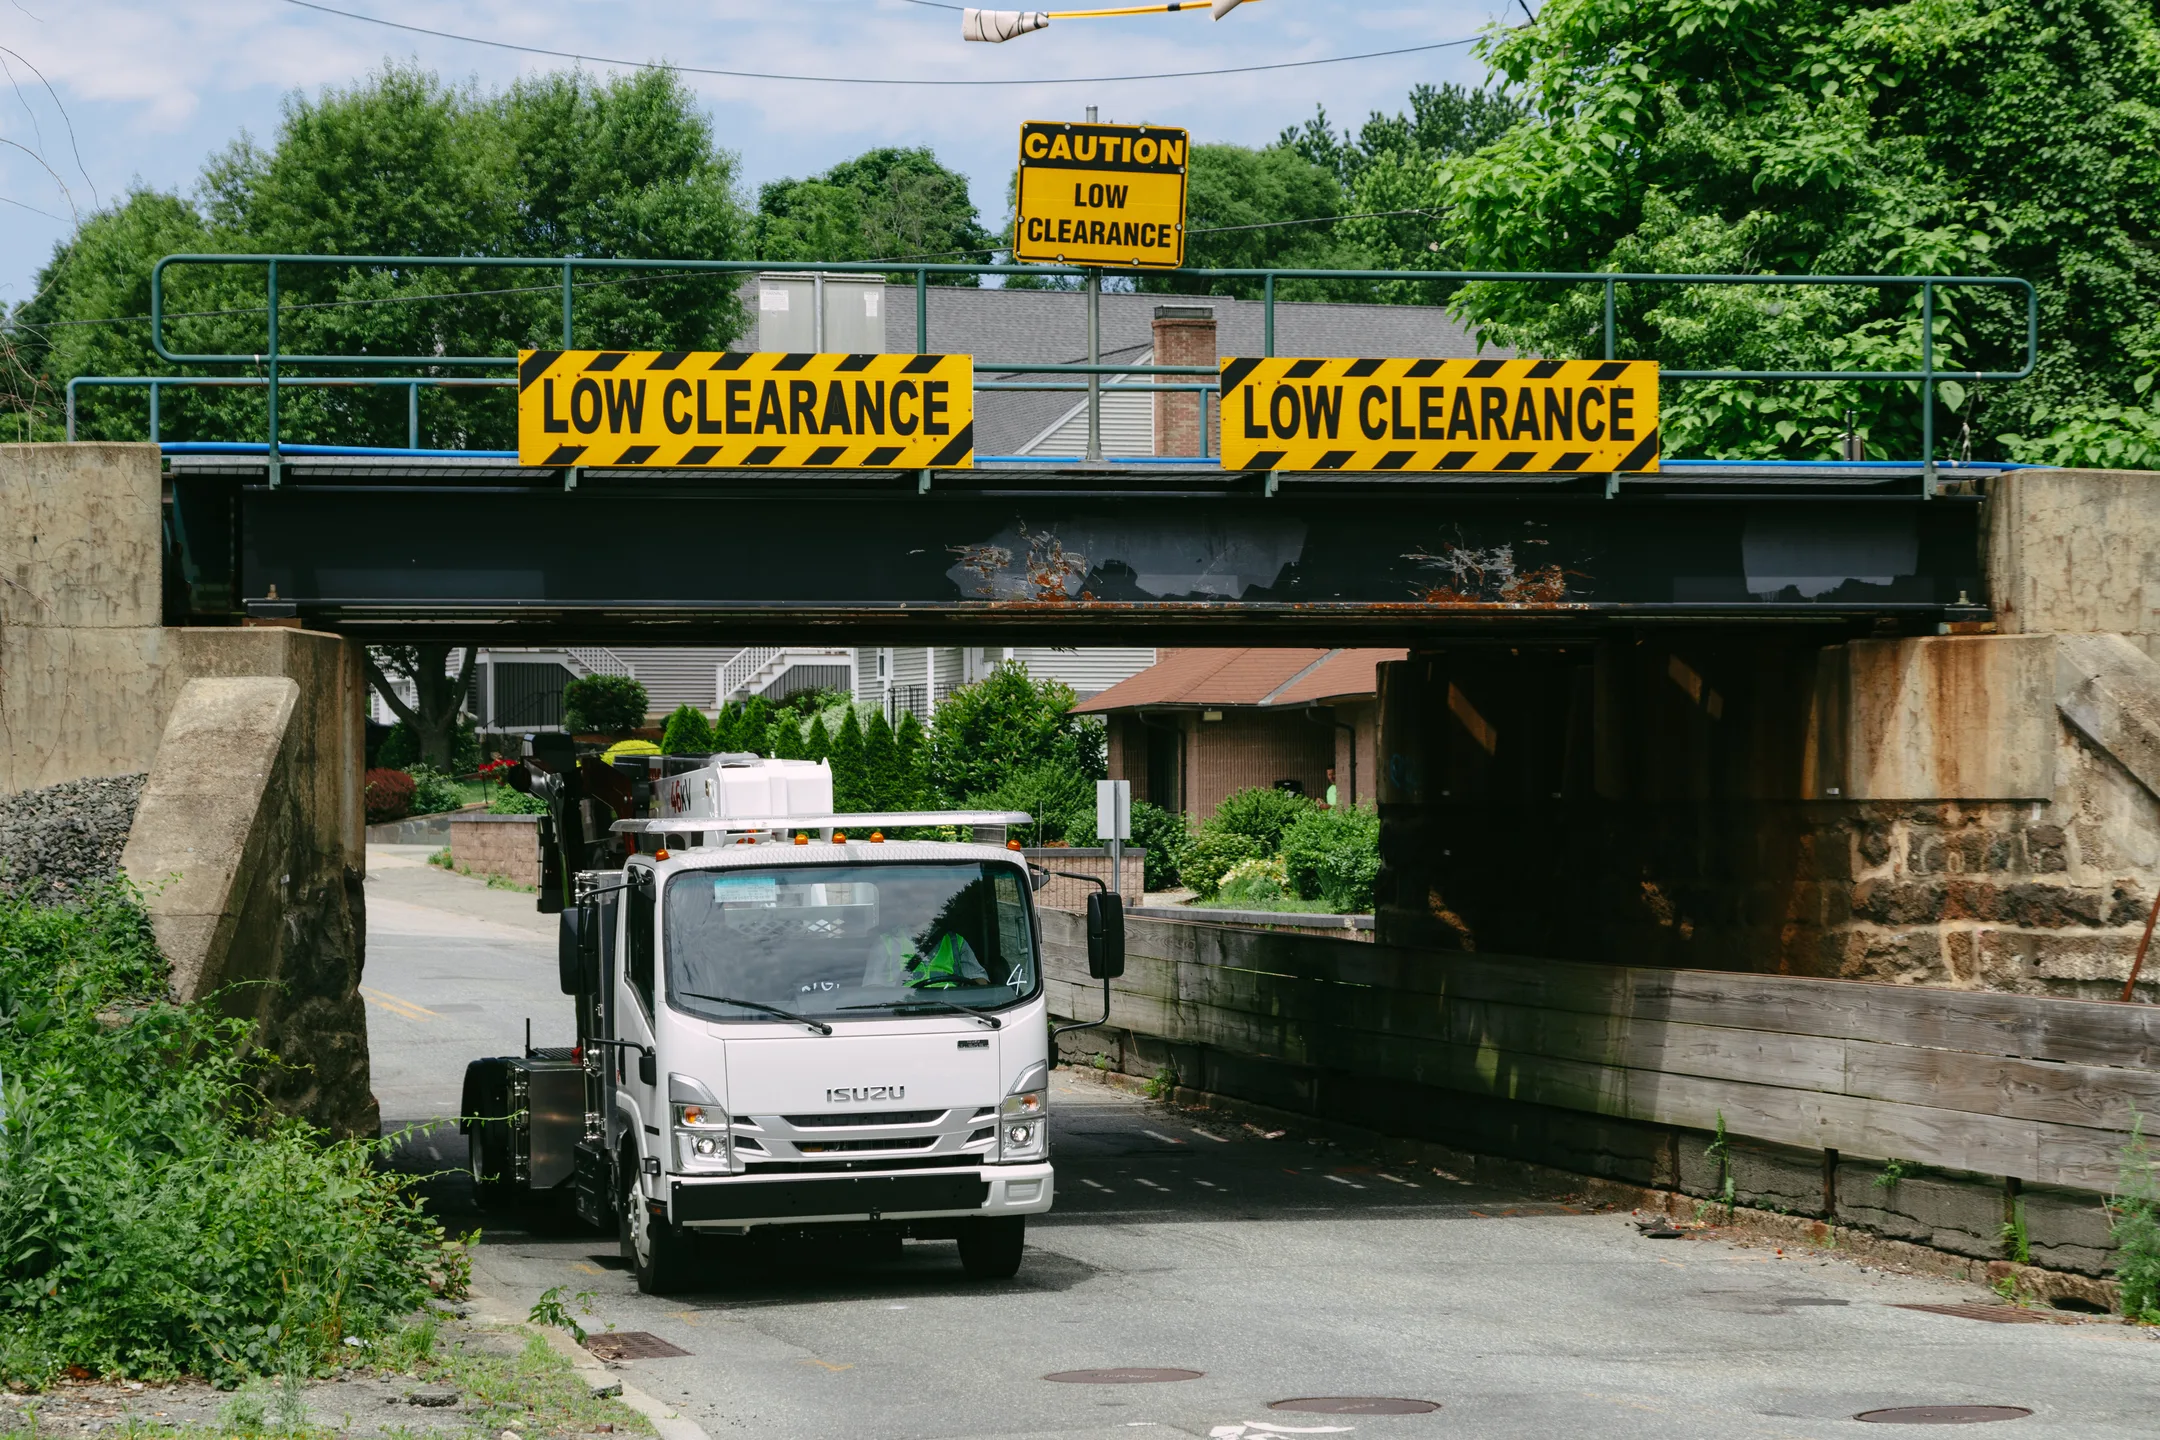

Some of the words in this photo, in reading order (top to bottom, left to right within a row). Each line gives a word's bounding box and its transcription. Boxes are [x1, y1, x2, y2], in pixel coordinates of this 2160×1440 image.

[1025, 133, 1183, 165] CAUTION
[1074, 183, 1129, 208] LOW
[1027, 217, 1172, 248] CLEARANCE
[543, 377, 647, 434] LOW
[663, 378, 950, 435] CLEARANCE
[1244, 384, 1343, 440] LOW
[1359, 385, 1635, 442] CLEARANCE
[1006, 963, 1027, 995] 4
[826, 1085, 905, 1103] ISUZU
